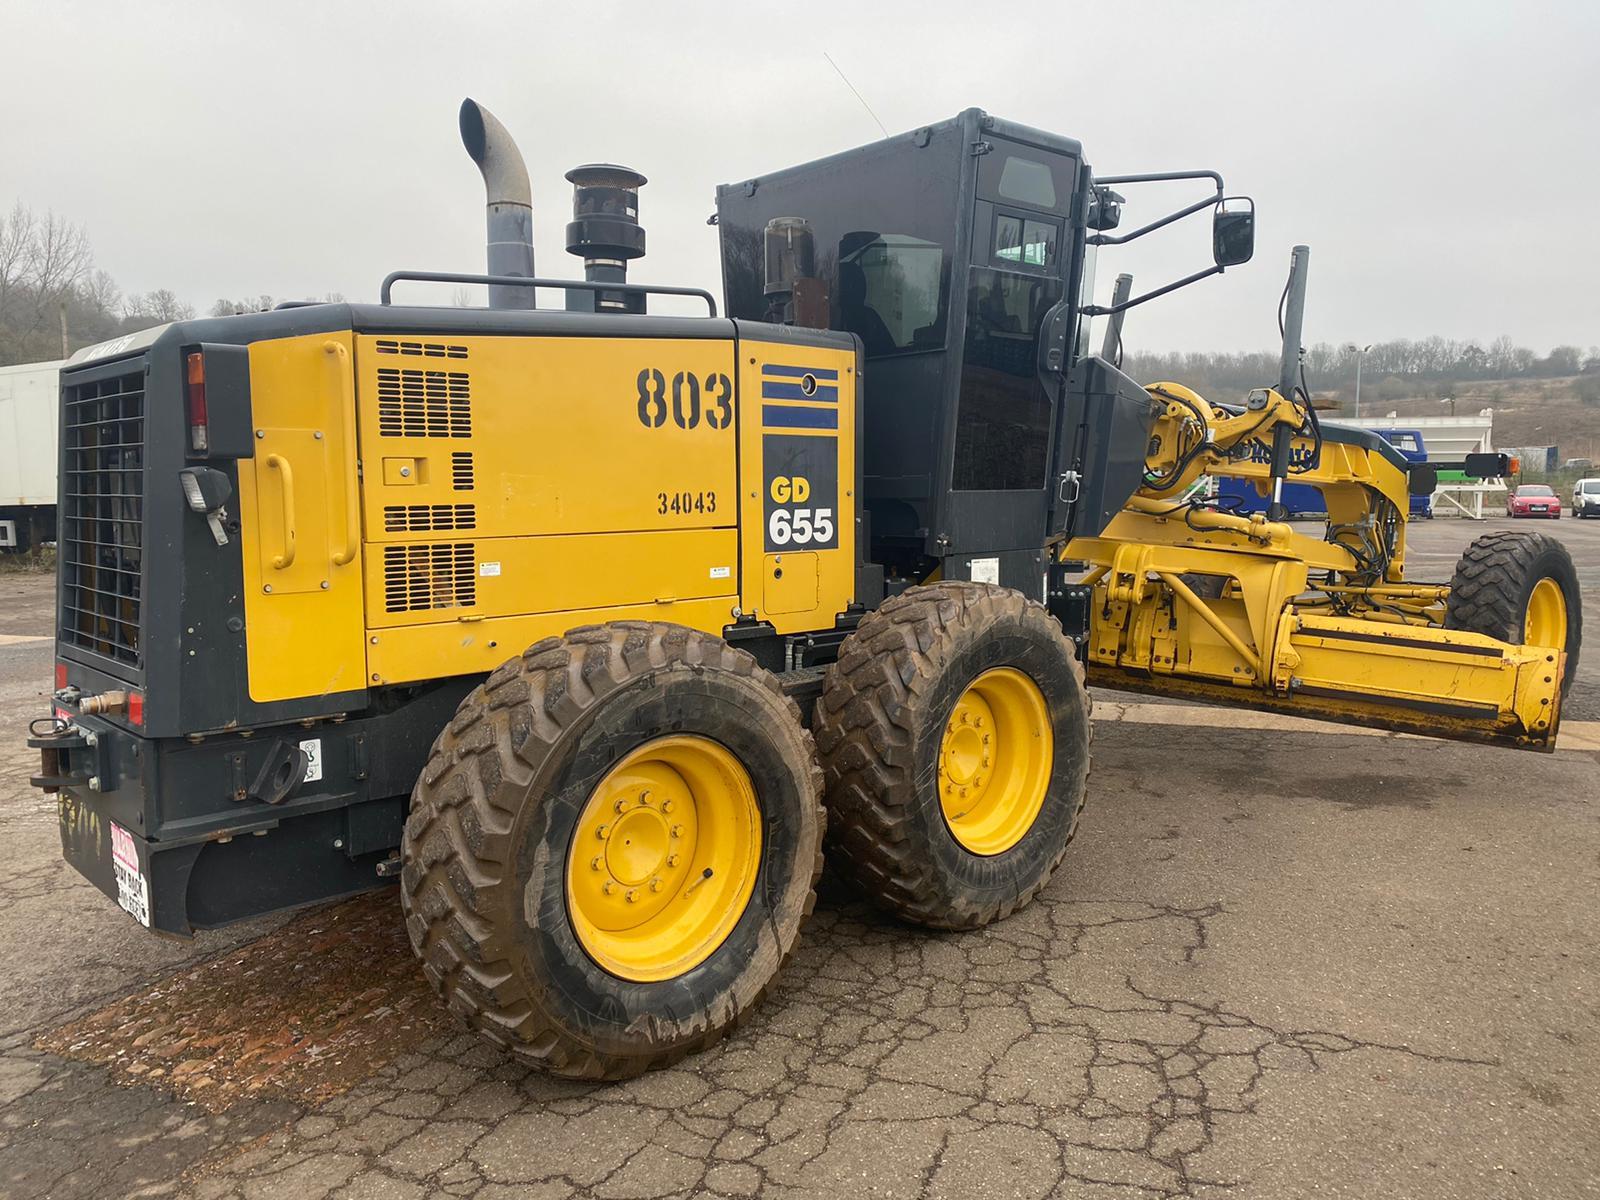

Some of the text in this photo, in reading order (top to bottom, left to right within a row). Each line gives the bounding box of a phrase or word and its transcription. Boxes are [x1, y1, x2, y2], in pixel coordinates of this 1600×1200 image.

[637, 368, 732, 430] 803
[657, 491, 716, 515] 34043
[770, 476, 810, 503] GD
[769, 508, 833, 545] 655
